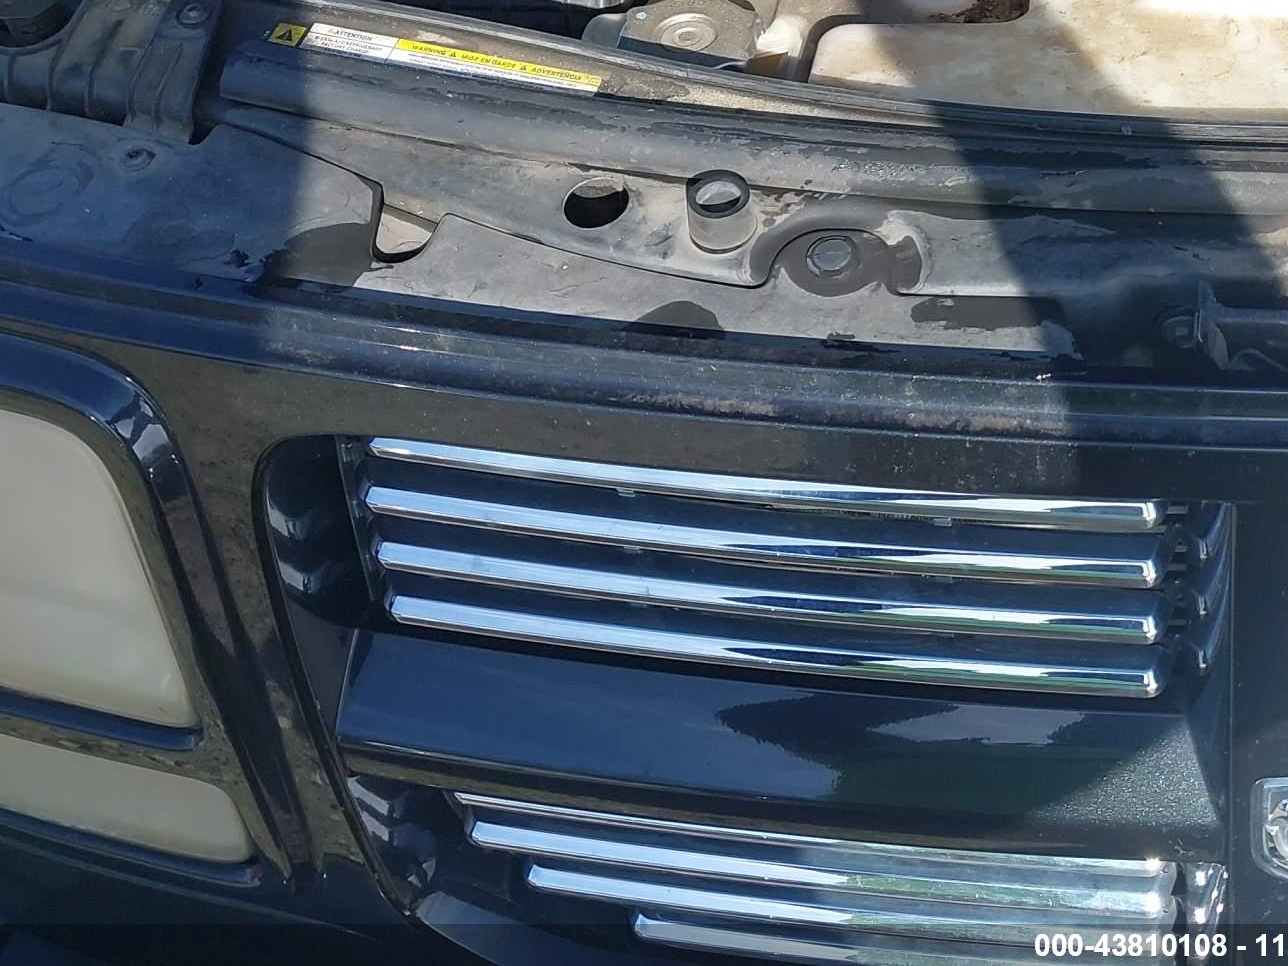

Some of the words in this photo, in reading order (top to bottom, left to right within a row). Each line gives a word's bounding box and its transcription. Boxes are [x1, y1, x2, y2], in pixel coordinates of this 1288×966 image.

[411, 44, 447, 56] WARNING
[462, 53, 479, 62] MISE
[491, 59, 516, 69] GARDE
[532, 67, 582, 81] ADVERTENCIA
